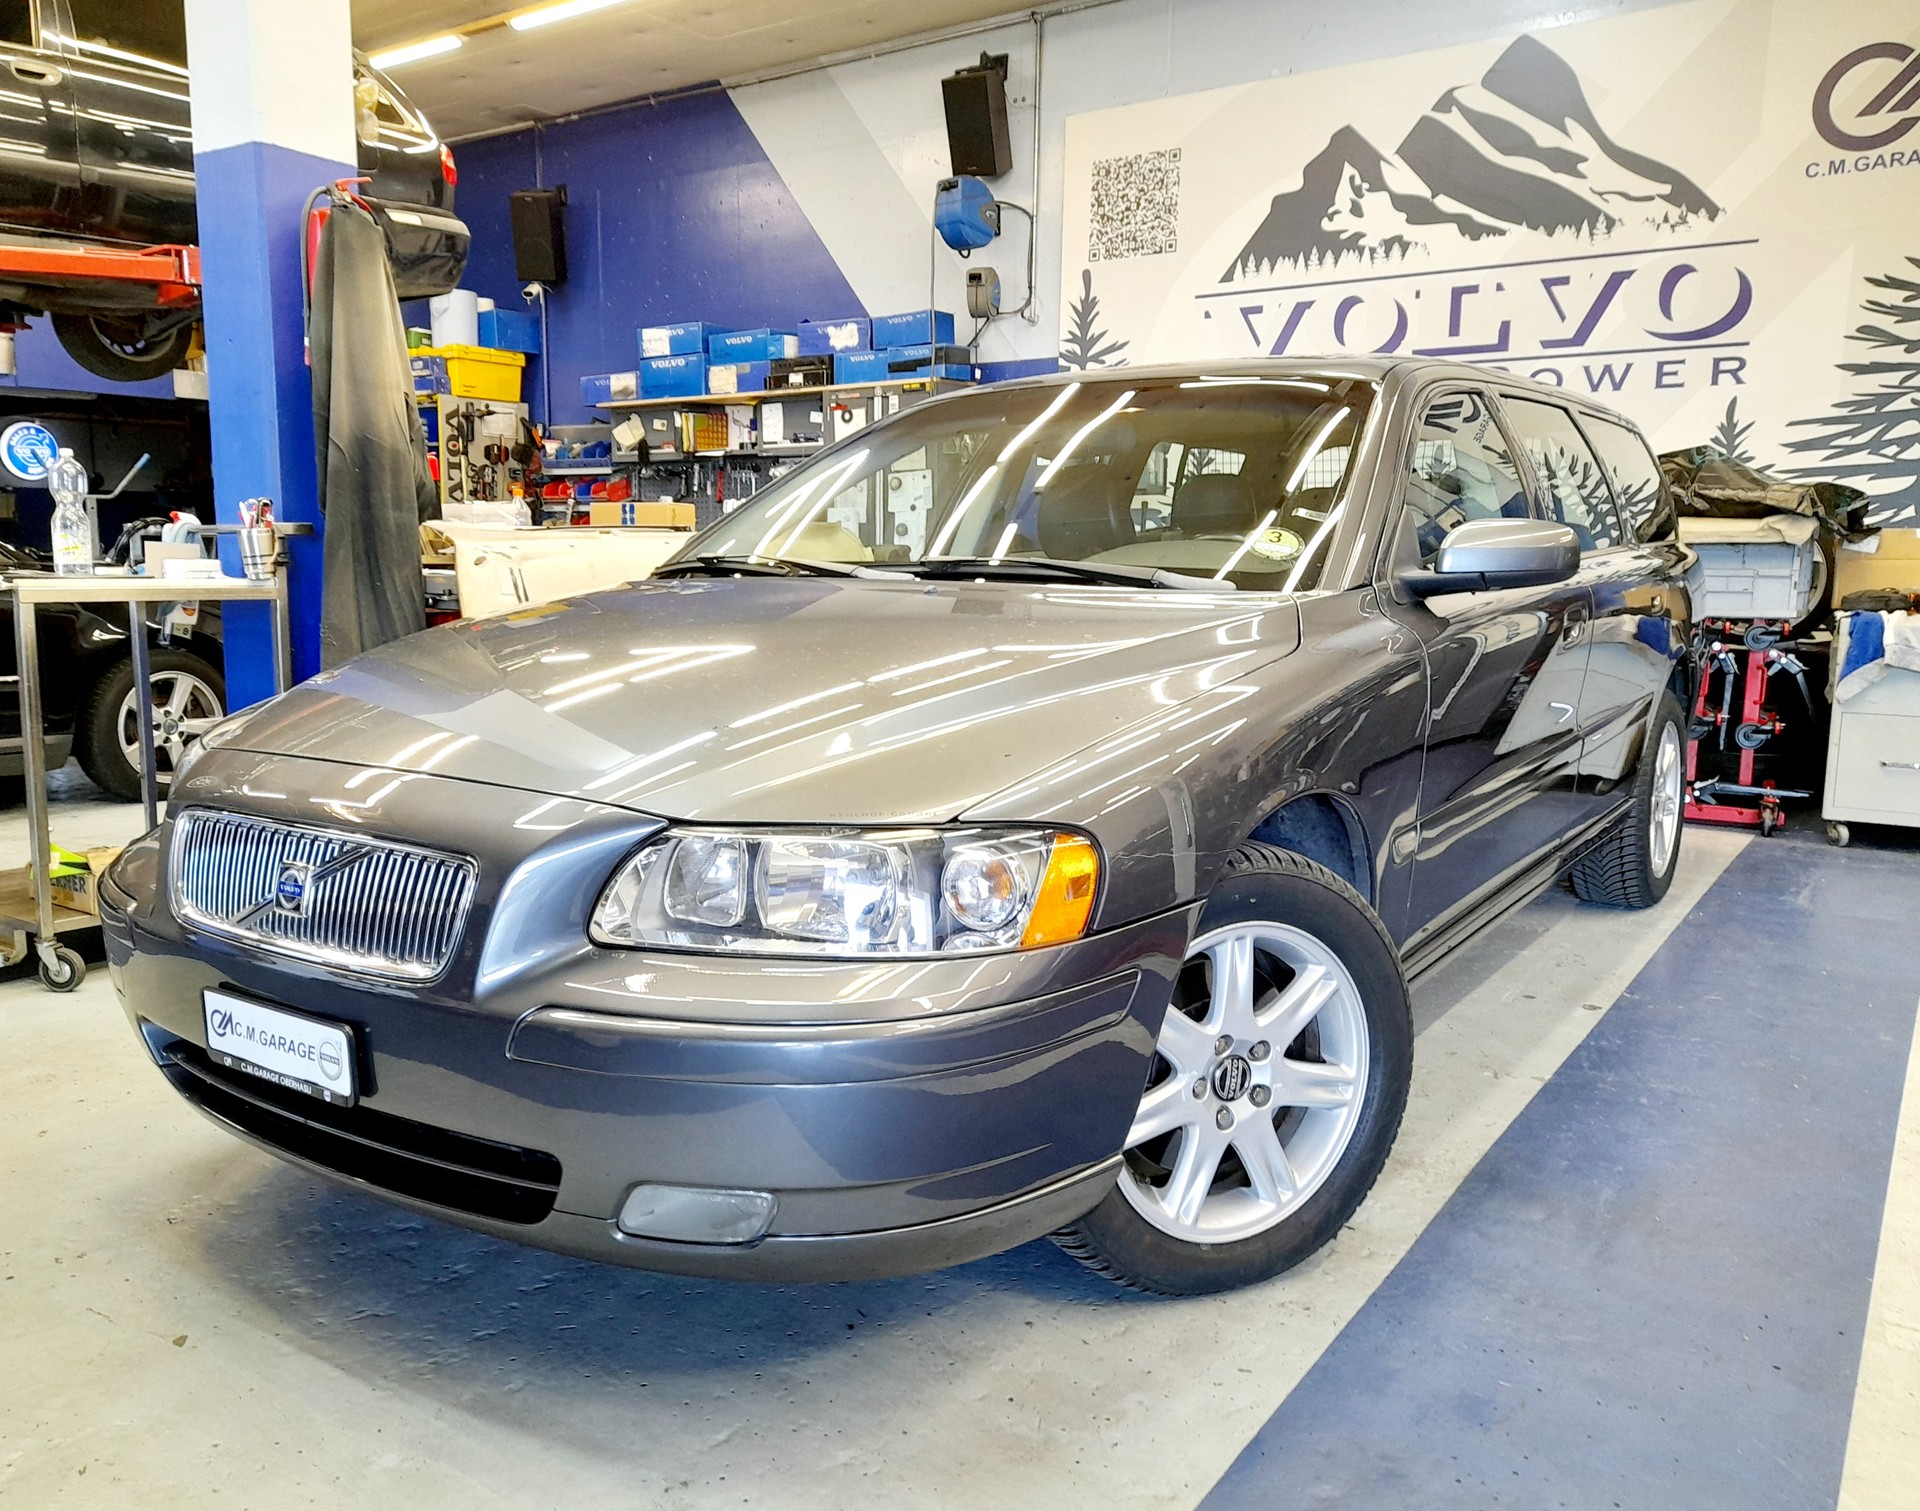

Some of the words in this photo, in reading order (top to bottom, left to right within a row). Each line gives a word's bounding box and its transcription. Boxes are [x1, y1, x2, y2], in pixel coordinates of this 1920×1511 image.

[1204, 263, 1753, 356] VOLVO
[887, 315, 914, 325] VOLVO
[724, 335, 753, 346] VOLVO
[849, 353, 875, 362] VOLVO
[903, 348, 929, 357] VOLVO
[650, 358, 685, 369] VOLVO
[1490, 356, 1748, 393] OWER
[445, 403, 466, 503] VOLV
[1268, 531, 1282, 543] 3
[234, 1021, 316, 1062] C.M.GARAGE
[1227, 1058, 1239, 1100] VOLVO
